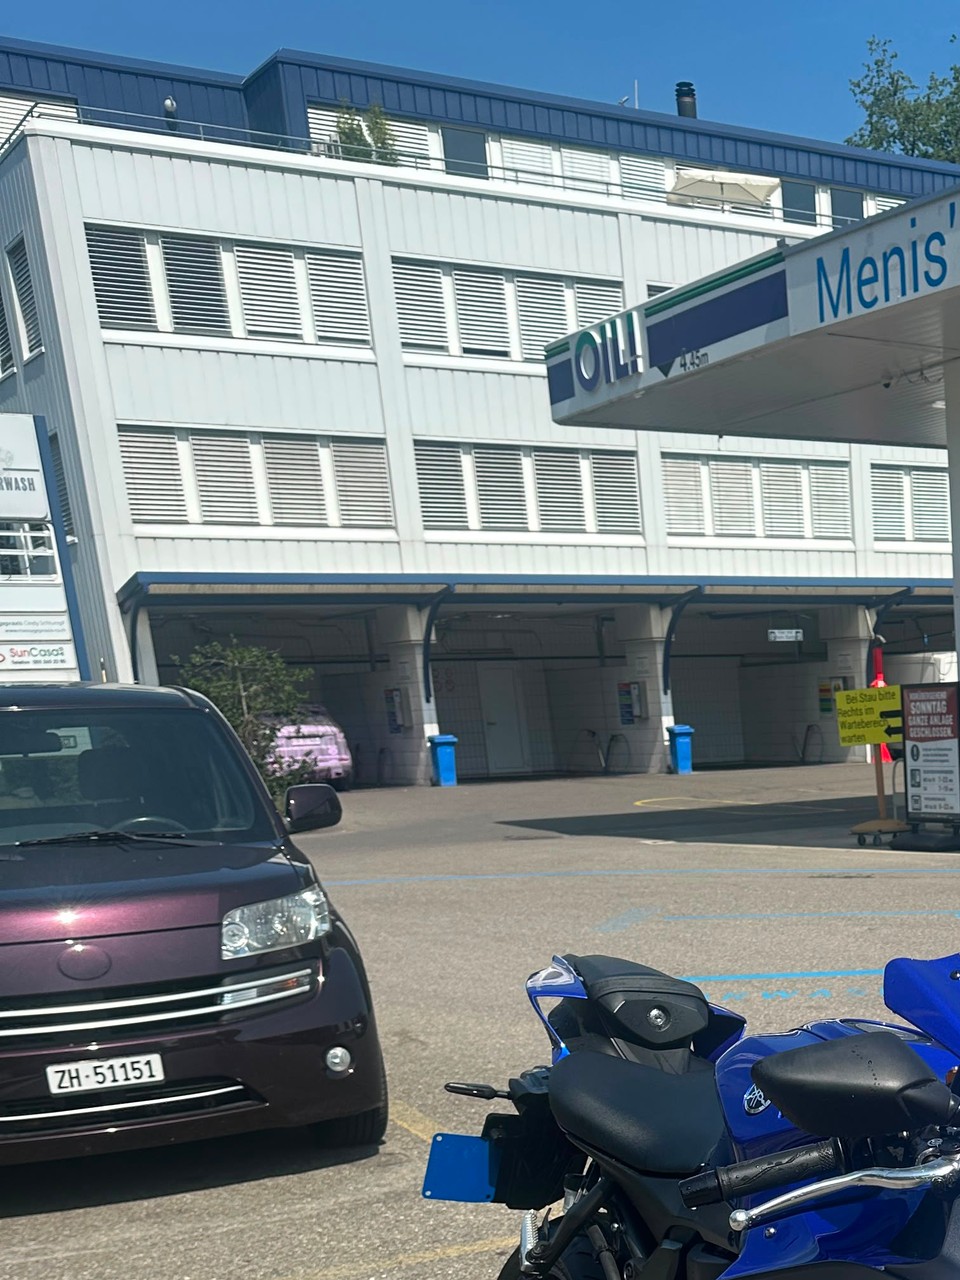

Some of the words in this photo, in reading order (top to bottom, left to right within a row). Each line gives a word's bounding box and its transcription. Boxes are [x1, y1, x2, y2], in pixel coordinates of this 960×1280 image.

[910, 701, 948, 714] SONNTAG
[908, 715, 929, 726] GANZE
[929, 714, 954, 725] ANLAGE
